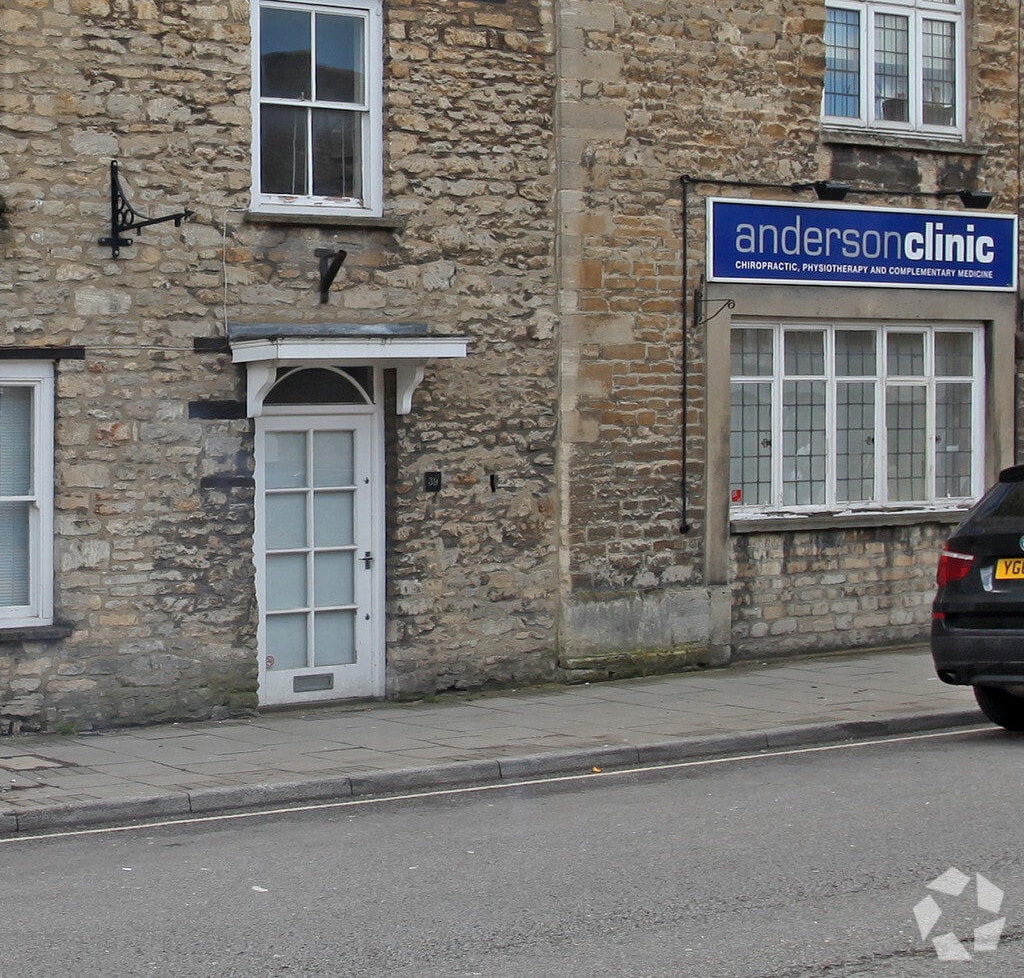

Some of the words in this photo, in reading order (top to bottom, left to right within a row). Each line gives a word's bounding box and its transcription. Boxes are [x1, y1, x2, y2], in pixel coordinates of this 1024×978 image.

[735, 261, 800, 272] CHIROPRACTIC,
[802, 263, 869, 274] PHYSIOTHERAPY
[870, 266, 887, 275] AND
[888, 266, 956, 278] COMPLEMENTARY
[957, 269, 993, 279] MEDICINE
[1004, 560, 1024, 575] YG
